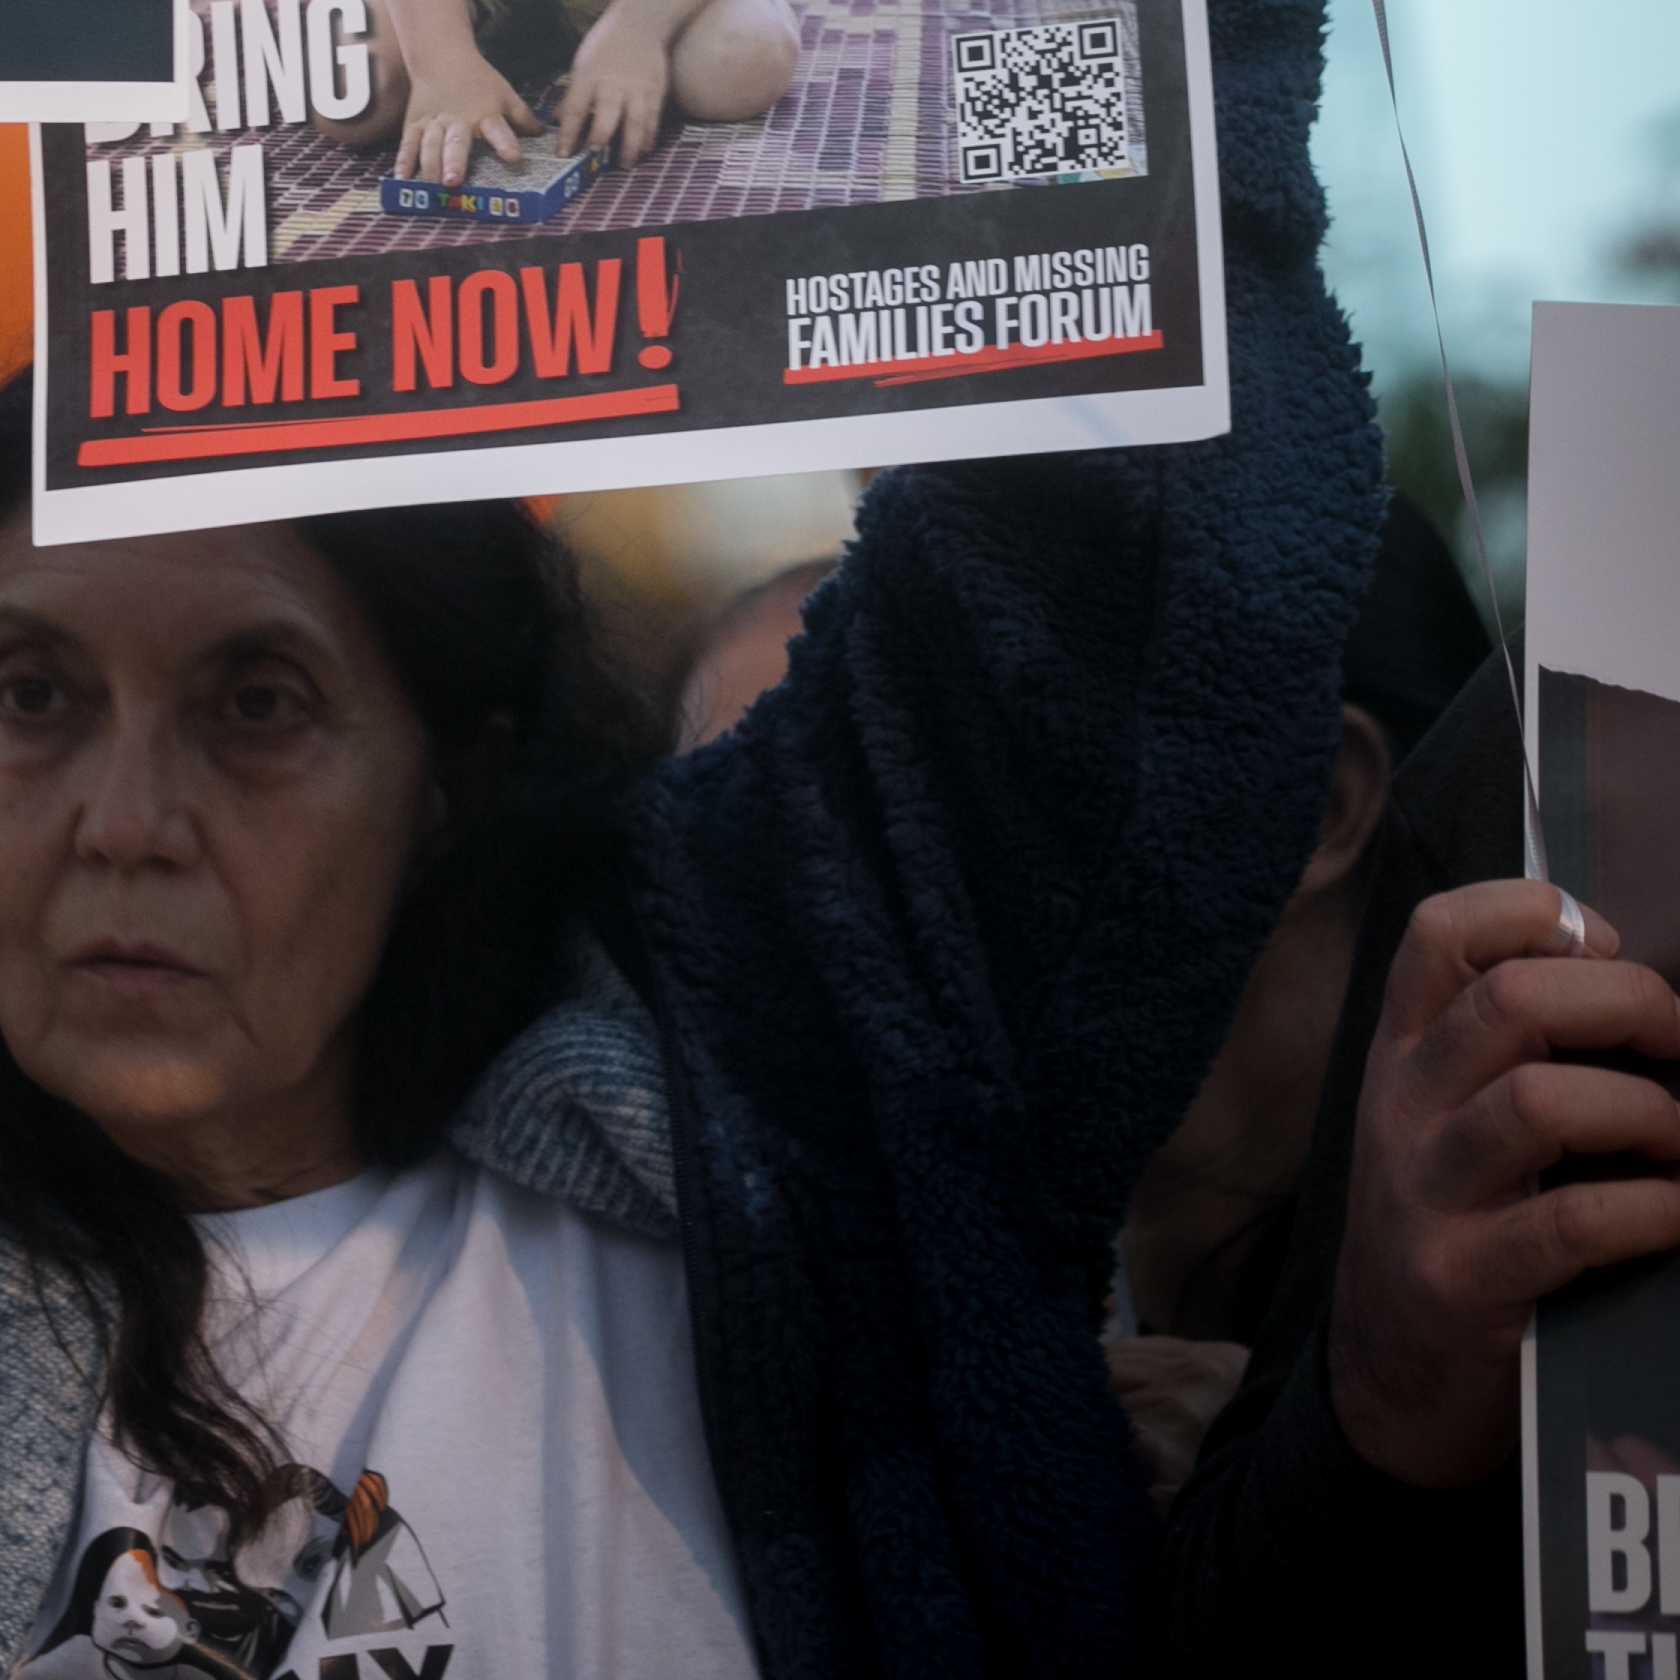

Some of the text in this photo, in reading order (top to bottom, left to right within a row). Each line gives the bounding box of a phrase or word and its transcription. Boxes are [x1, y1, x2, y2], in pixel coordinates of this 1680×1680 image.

[87, 143, 268, 284] HIM
[89, 236, 683, 419] HOME NOW!
[785, 243, 1151, 316] HOSTAGES AND MISSING
[787, 283, 1153, 371] FAMILIES FORUM
